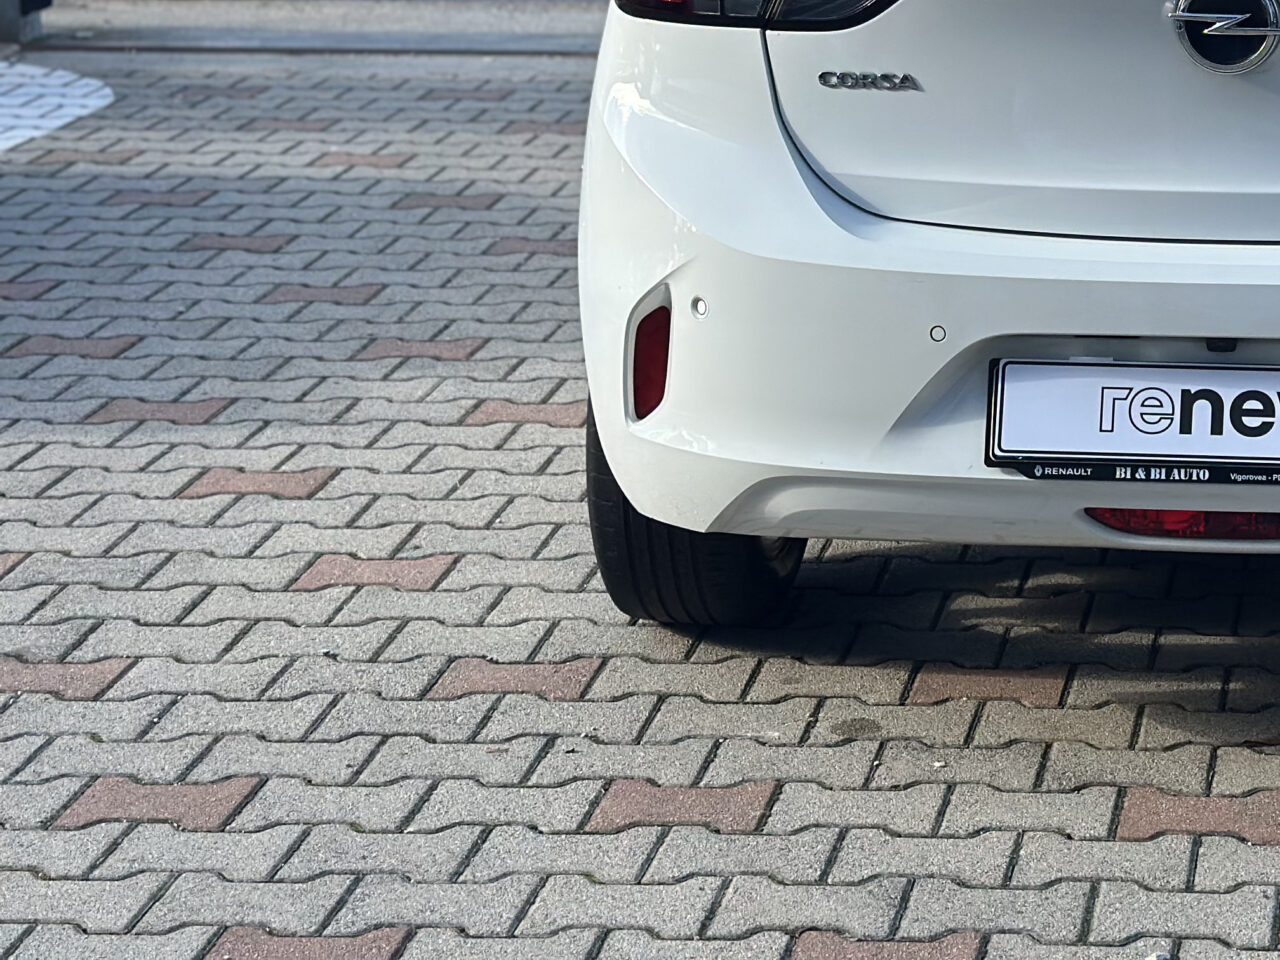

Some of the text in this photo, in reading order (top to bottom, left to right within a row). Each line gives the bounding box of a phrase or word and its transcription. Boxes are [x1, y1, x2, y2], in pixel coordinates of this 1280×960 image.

[818, 71, 921, 92] CORSA
[1044, 467, 1093, 476] RENAULT
[1115, 466, 1210, 481] BI & BI AUTO
